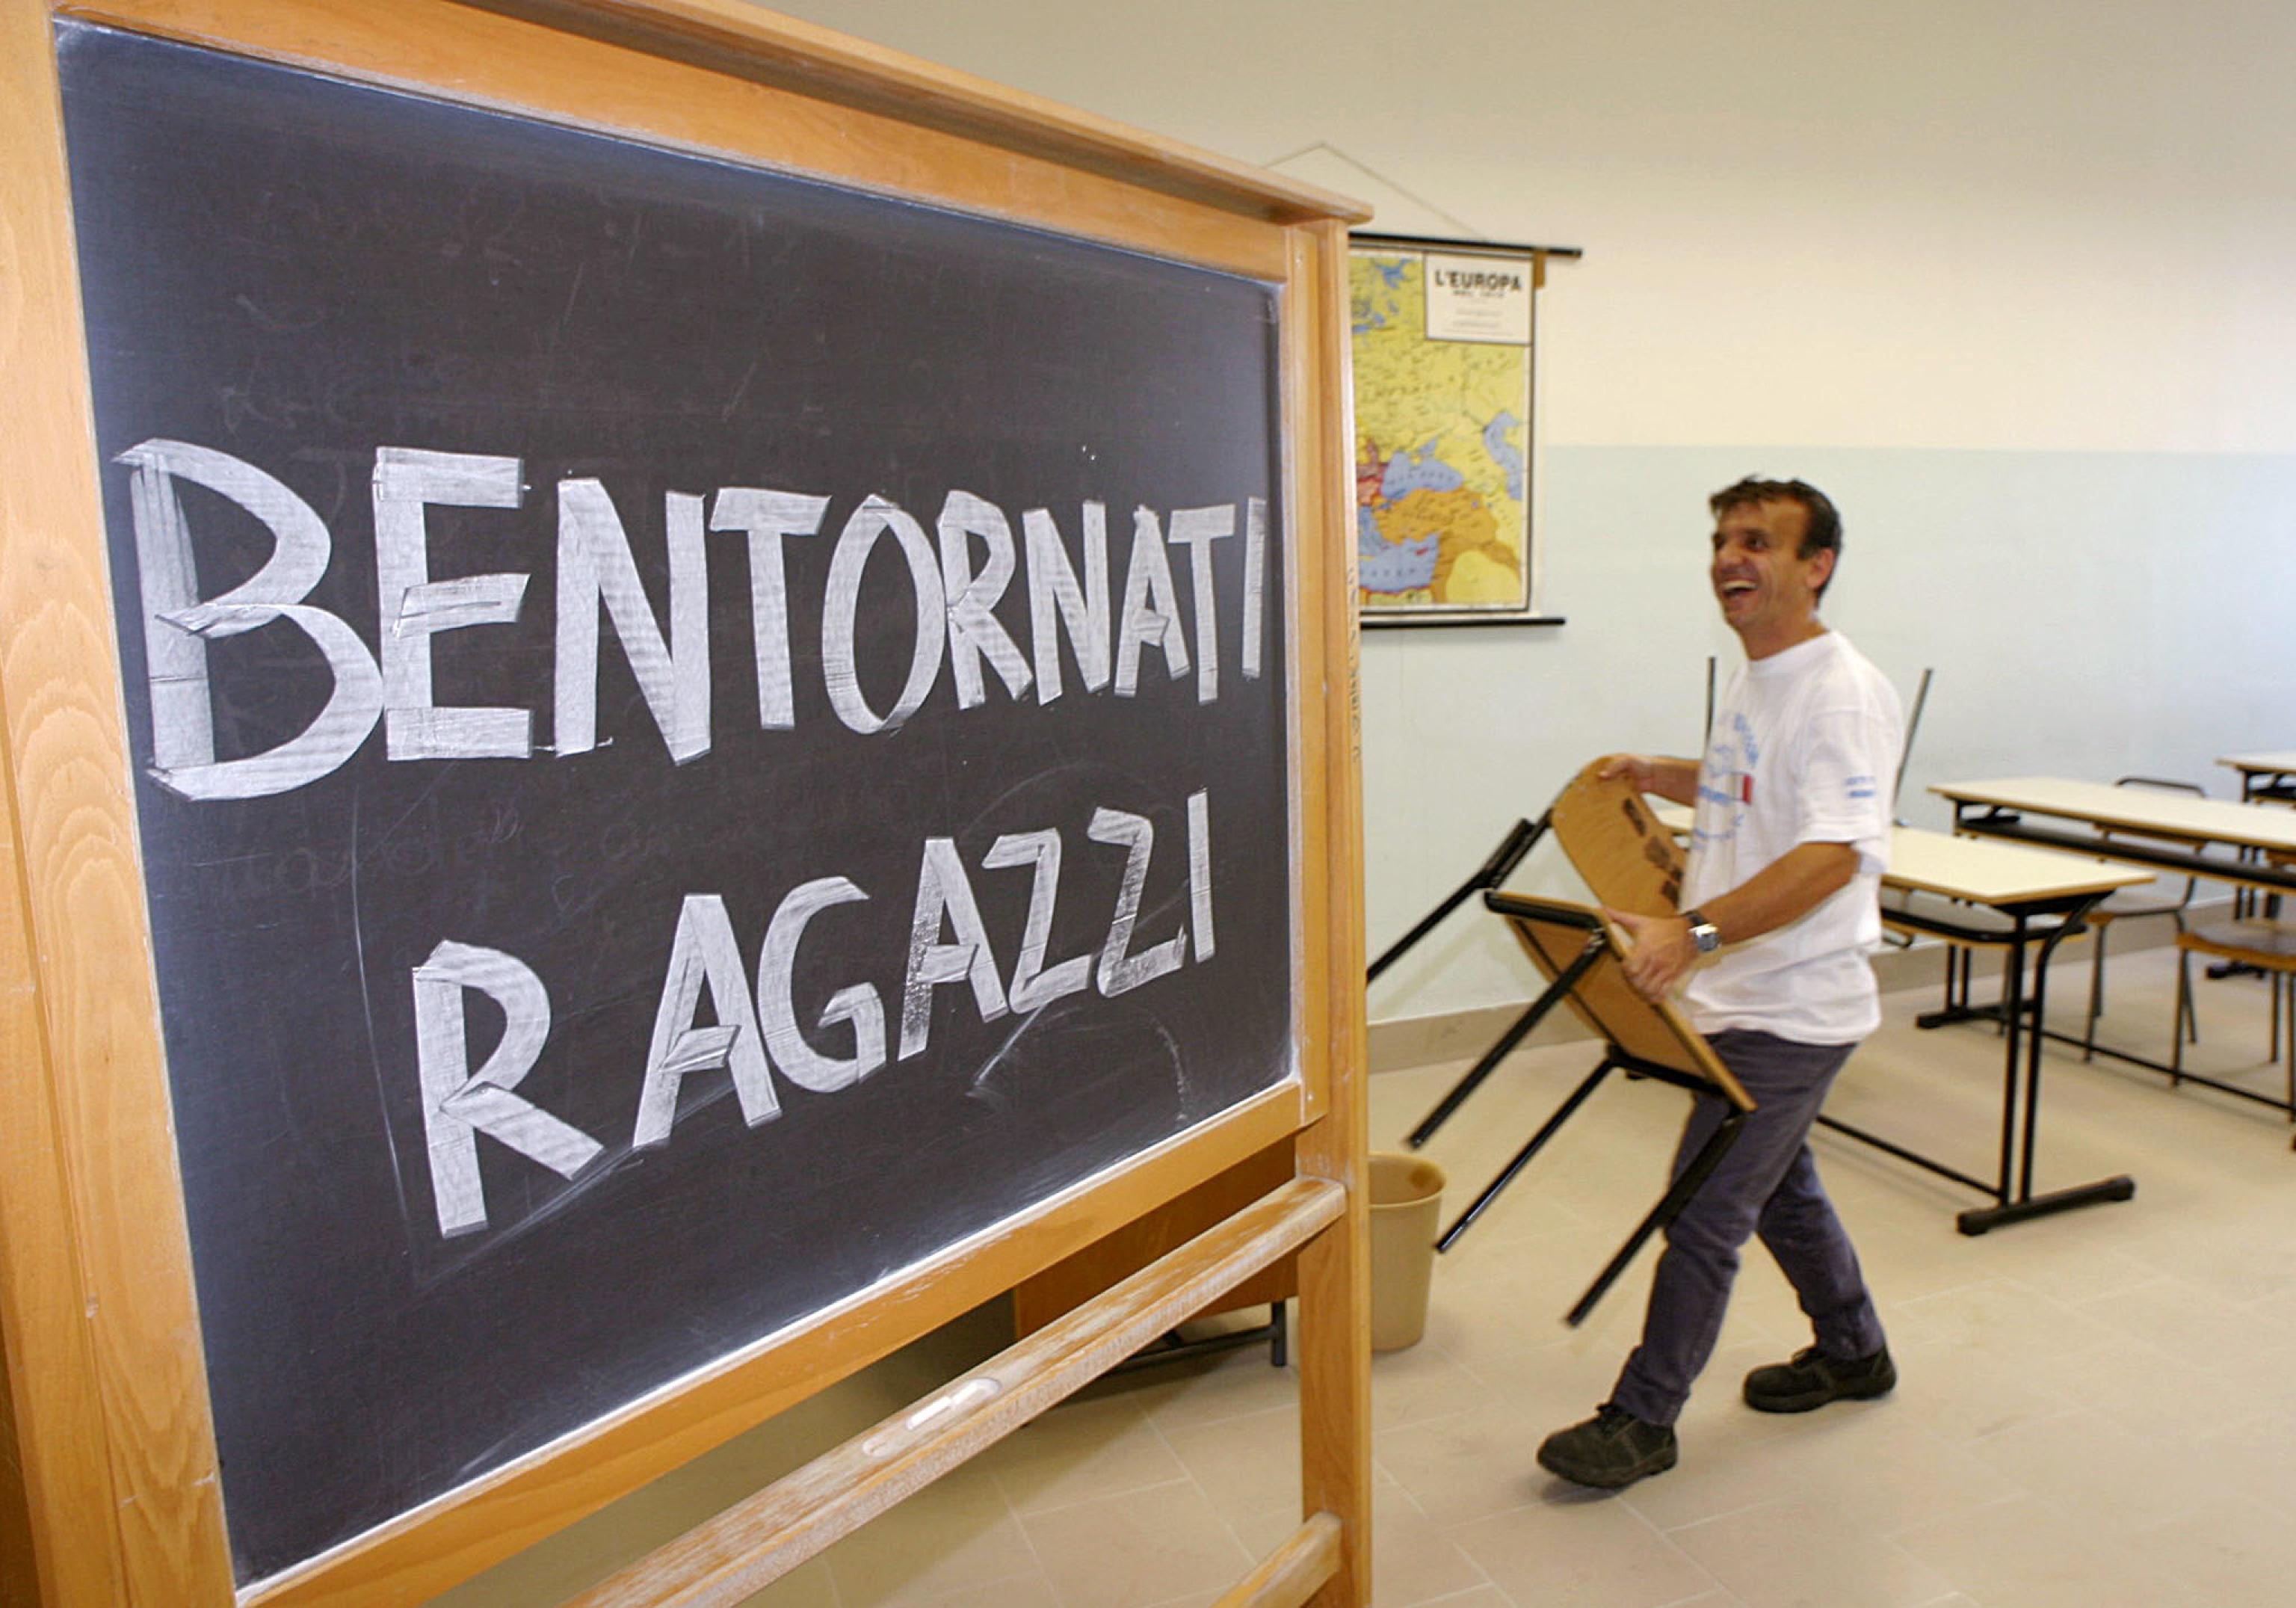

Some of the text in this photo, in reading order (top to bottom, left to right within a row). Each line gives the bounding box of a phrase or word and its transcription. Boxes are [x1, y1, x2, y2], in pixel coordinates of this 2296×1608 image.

[1434, 269, 1521, 291] L'EUROPA
[114, 438, 1266, 801] BENTORNATI
[412, 791, 1215, 1237] RAGAZZI
